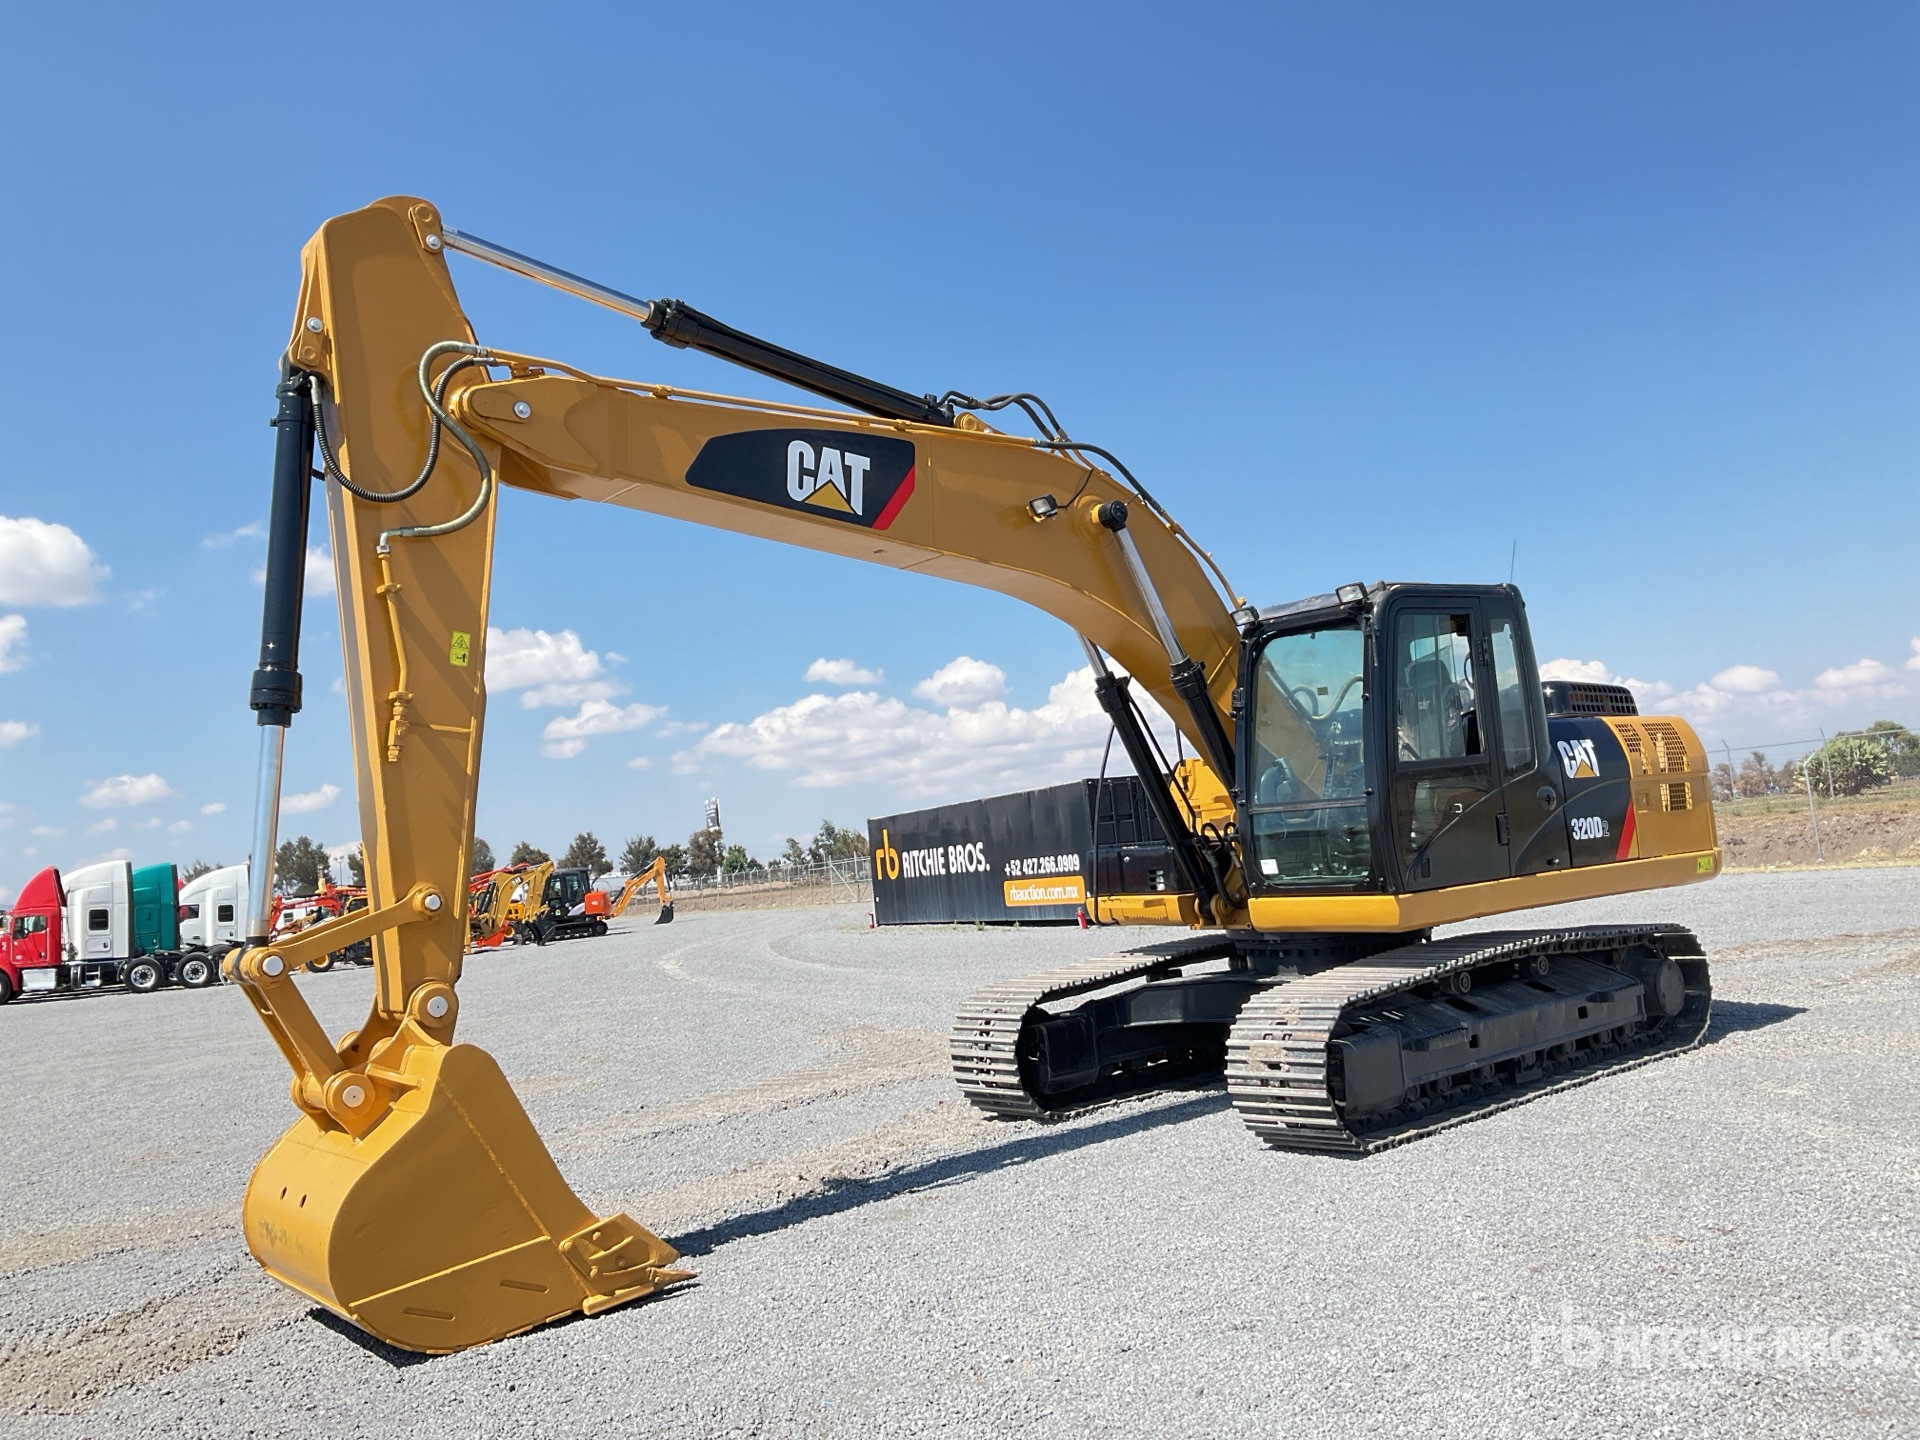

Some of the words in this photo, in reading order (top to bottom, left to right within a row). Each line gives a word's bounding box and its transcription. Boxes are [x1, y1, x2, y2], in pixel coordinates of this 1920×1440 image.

[787, 440, 870, 515] CAT
[1557, 738, 1600, 779] CAT
[902, 847, 946, 878] RITCHIE
[948, 841, 990, 874] BROS.
[1004, 859, 1021, 876] +52
[1022, 853, 1080, 875] 427.266.0909
[1010, 884, 1079, 902] rbauction.com.mx
